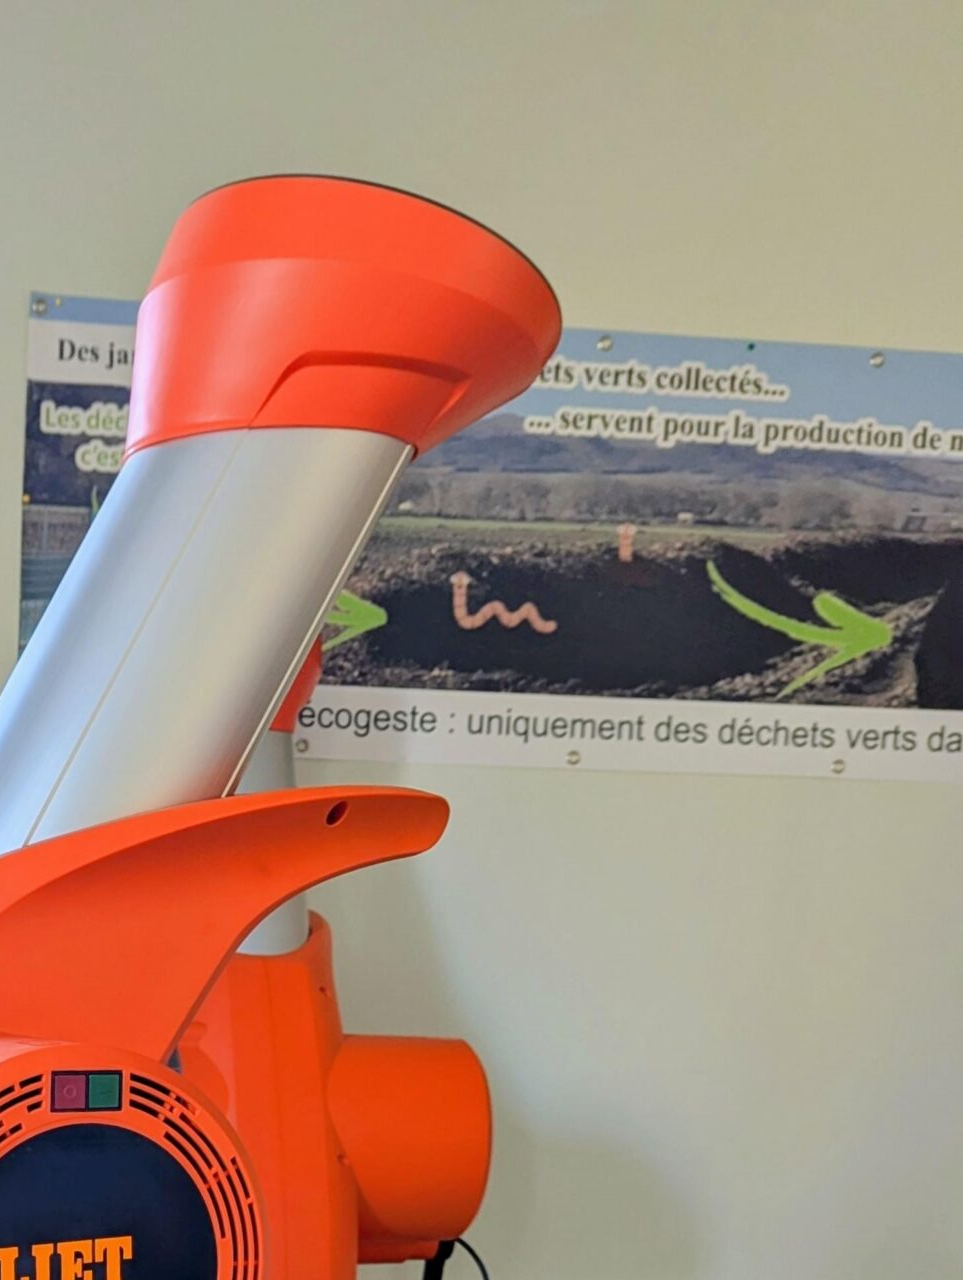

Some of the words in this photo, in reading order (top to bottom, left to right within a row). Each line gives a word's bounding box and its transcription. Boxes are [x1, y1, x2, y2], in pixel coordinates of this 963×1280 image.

[58, 338, 100, 362] Des
[106, 341, 135, 370] ja
[584, 366, 647, 388] verts
[655, 366, 786, 397] collectés...
[45, 406, 81, 430] Les
[559, 410, 655, 434] servent
[663, 416, 726, 442] pour
[733, 415, 755, 440] la
[764, 419, 904, 449] production
[912, 425, 943, 451] de
[80, 443, 124, 467] c'es
[297, 700, 438, 738] écogeste
[467, 708, 645, 743] uniquement
[653, 715, 709, 744] des
[718, 716, 836, 749] déchets
[846, 724, 917, 752] verts
